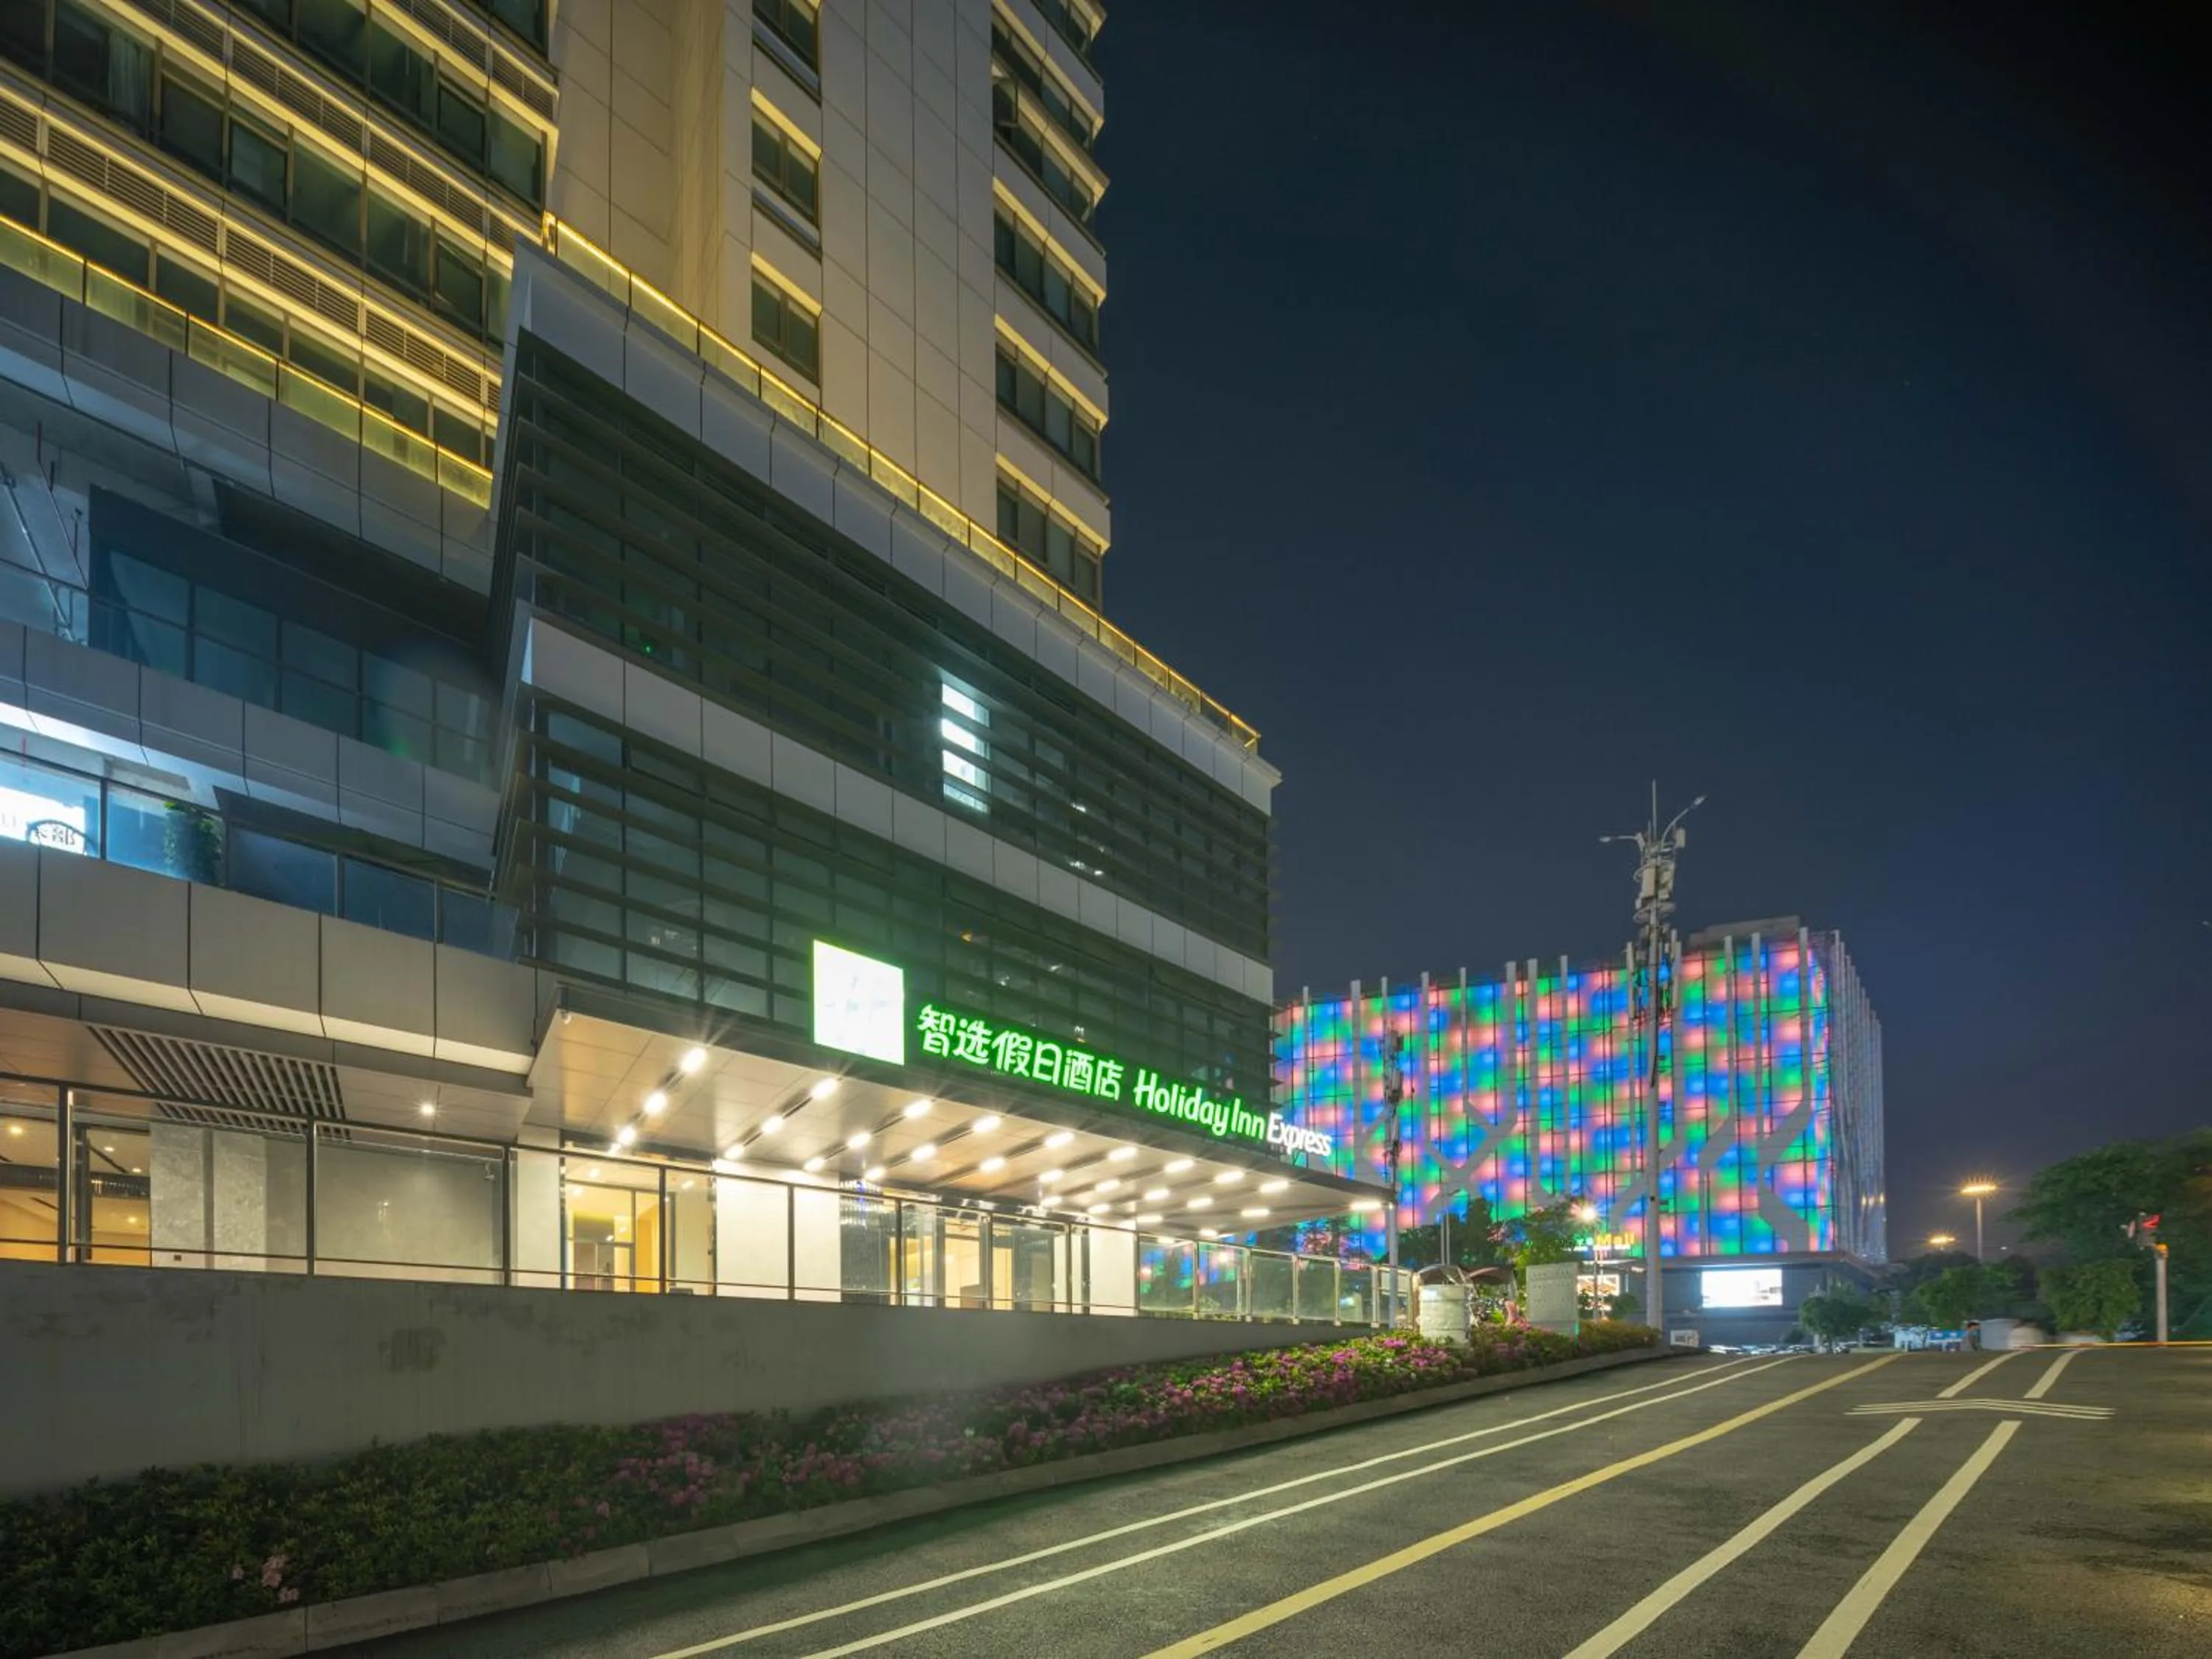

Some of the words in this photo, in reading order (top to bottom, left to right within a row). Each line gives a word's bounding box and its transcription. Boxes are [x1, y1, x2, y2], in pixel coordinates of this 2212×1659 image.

[917, 1004, 1124, 1102] 智选假日酒店
[1133, 1068, 1229, 1136] Holiday
[1231, 1097, 1266, 1140] Inn
[1266, 1111, 1333, 1156] Express
